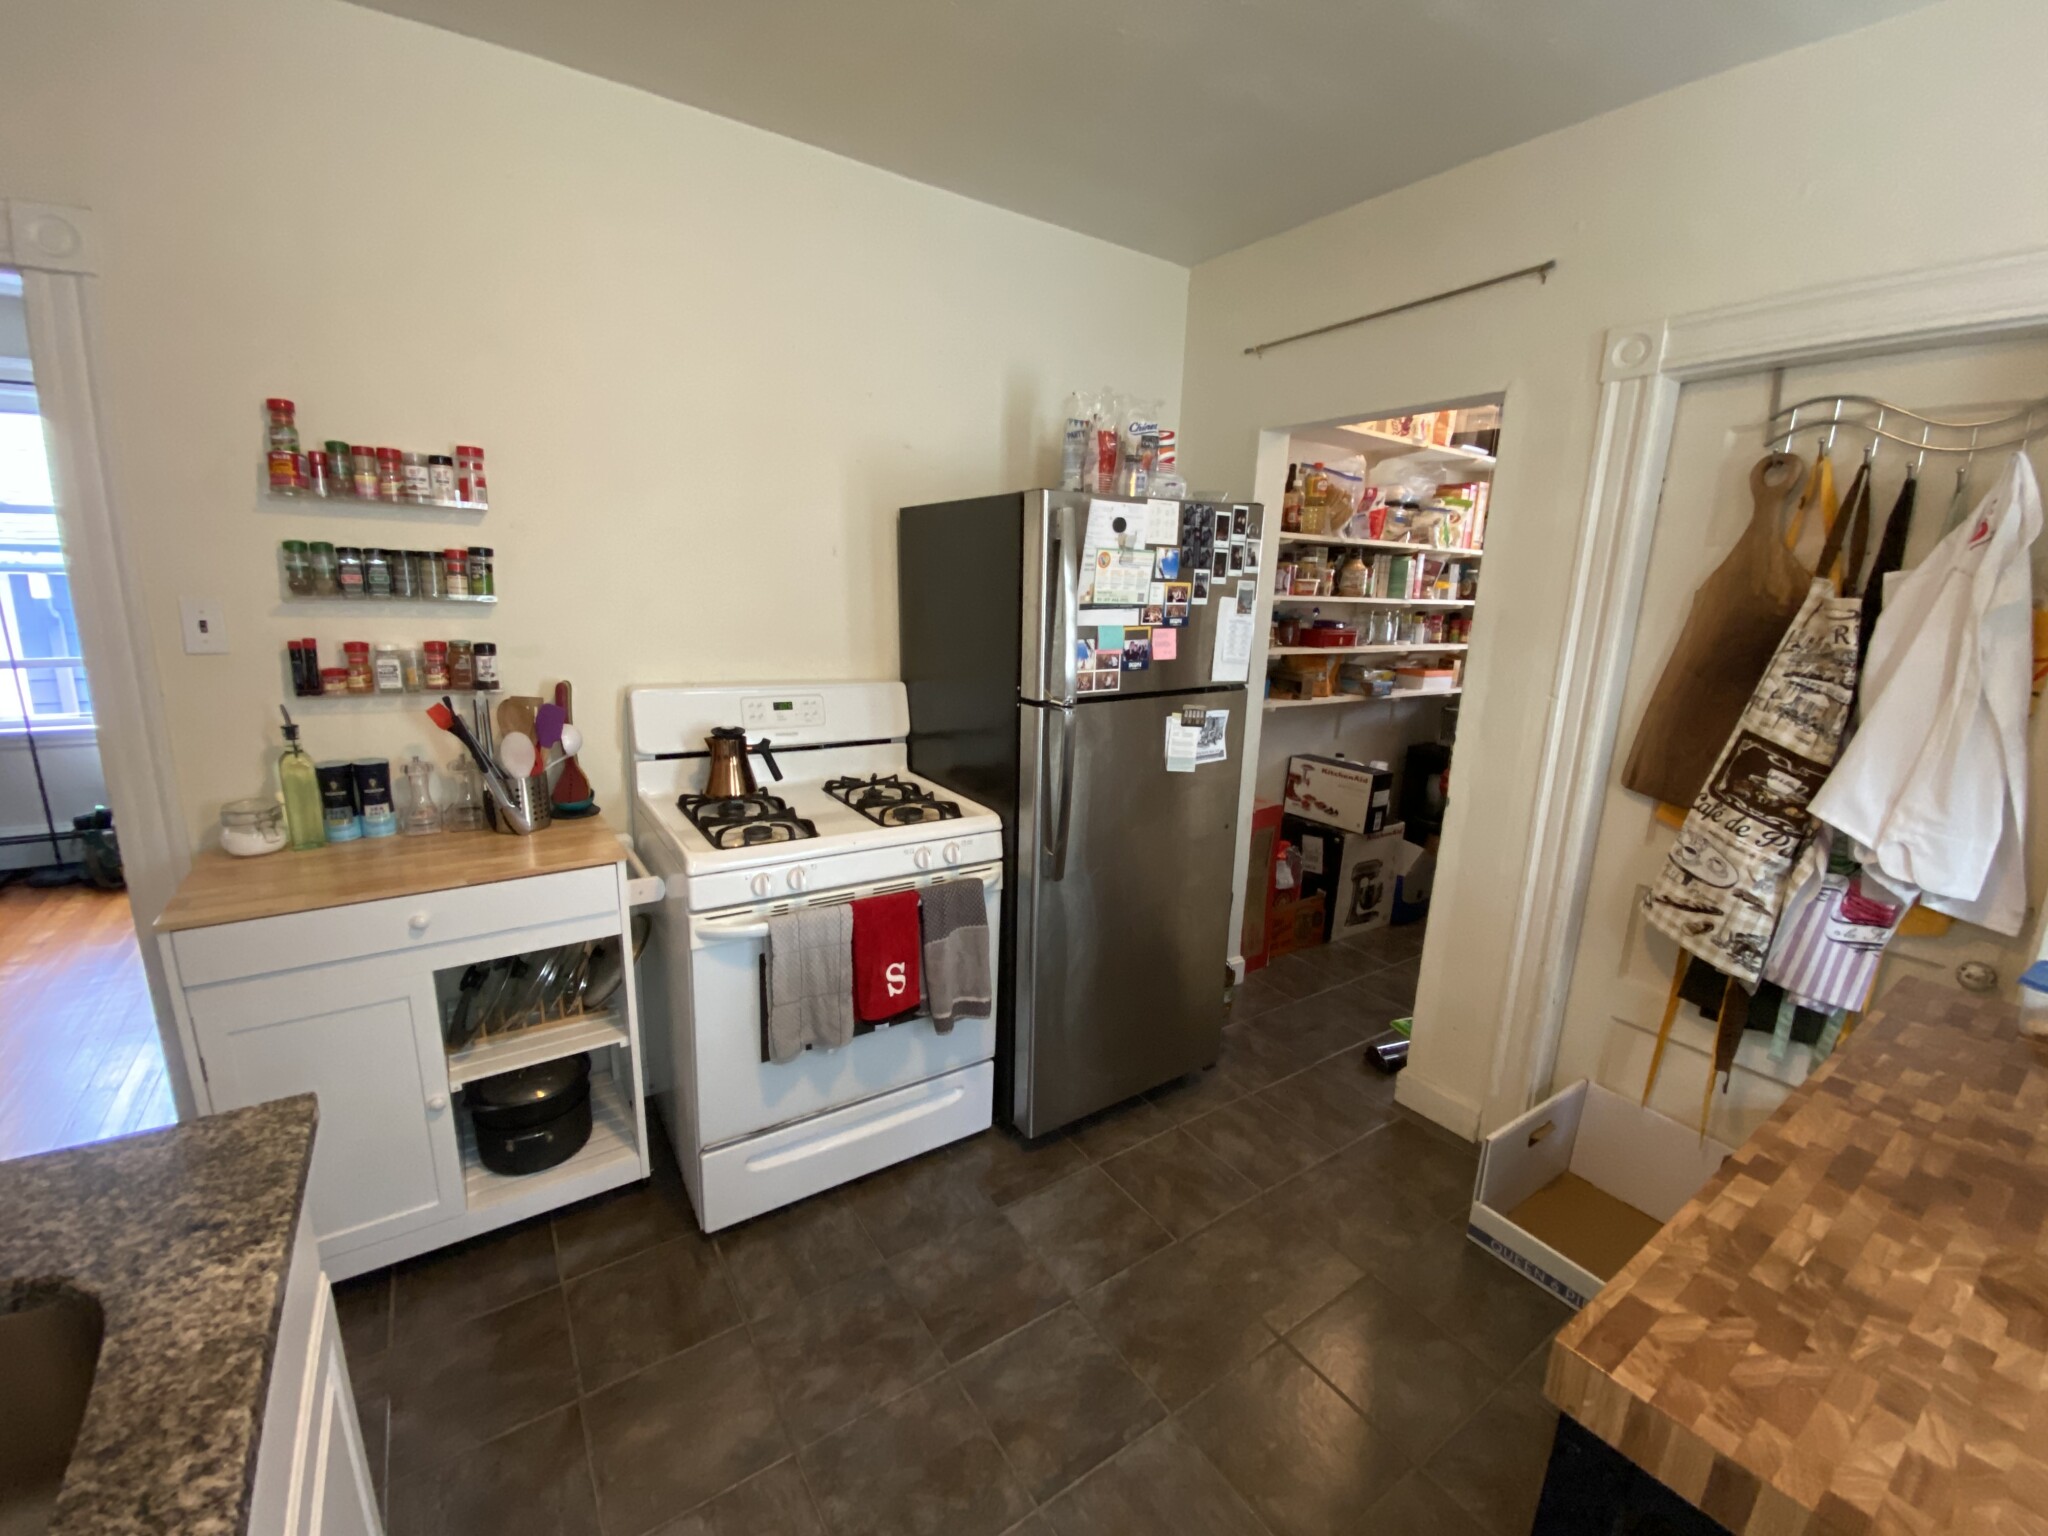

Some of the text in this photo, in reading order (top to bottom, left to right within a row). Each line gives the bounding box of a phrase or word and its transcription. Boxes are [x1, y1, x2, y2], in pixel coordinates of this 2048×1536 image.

[1321, 767, 1369, 784] KitchenAid
[1724, 815, 1751, 837] de
[886, 961, 906, 997] S
[1491, 1240, 1546, 1282] QUEEN
